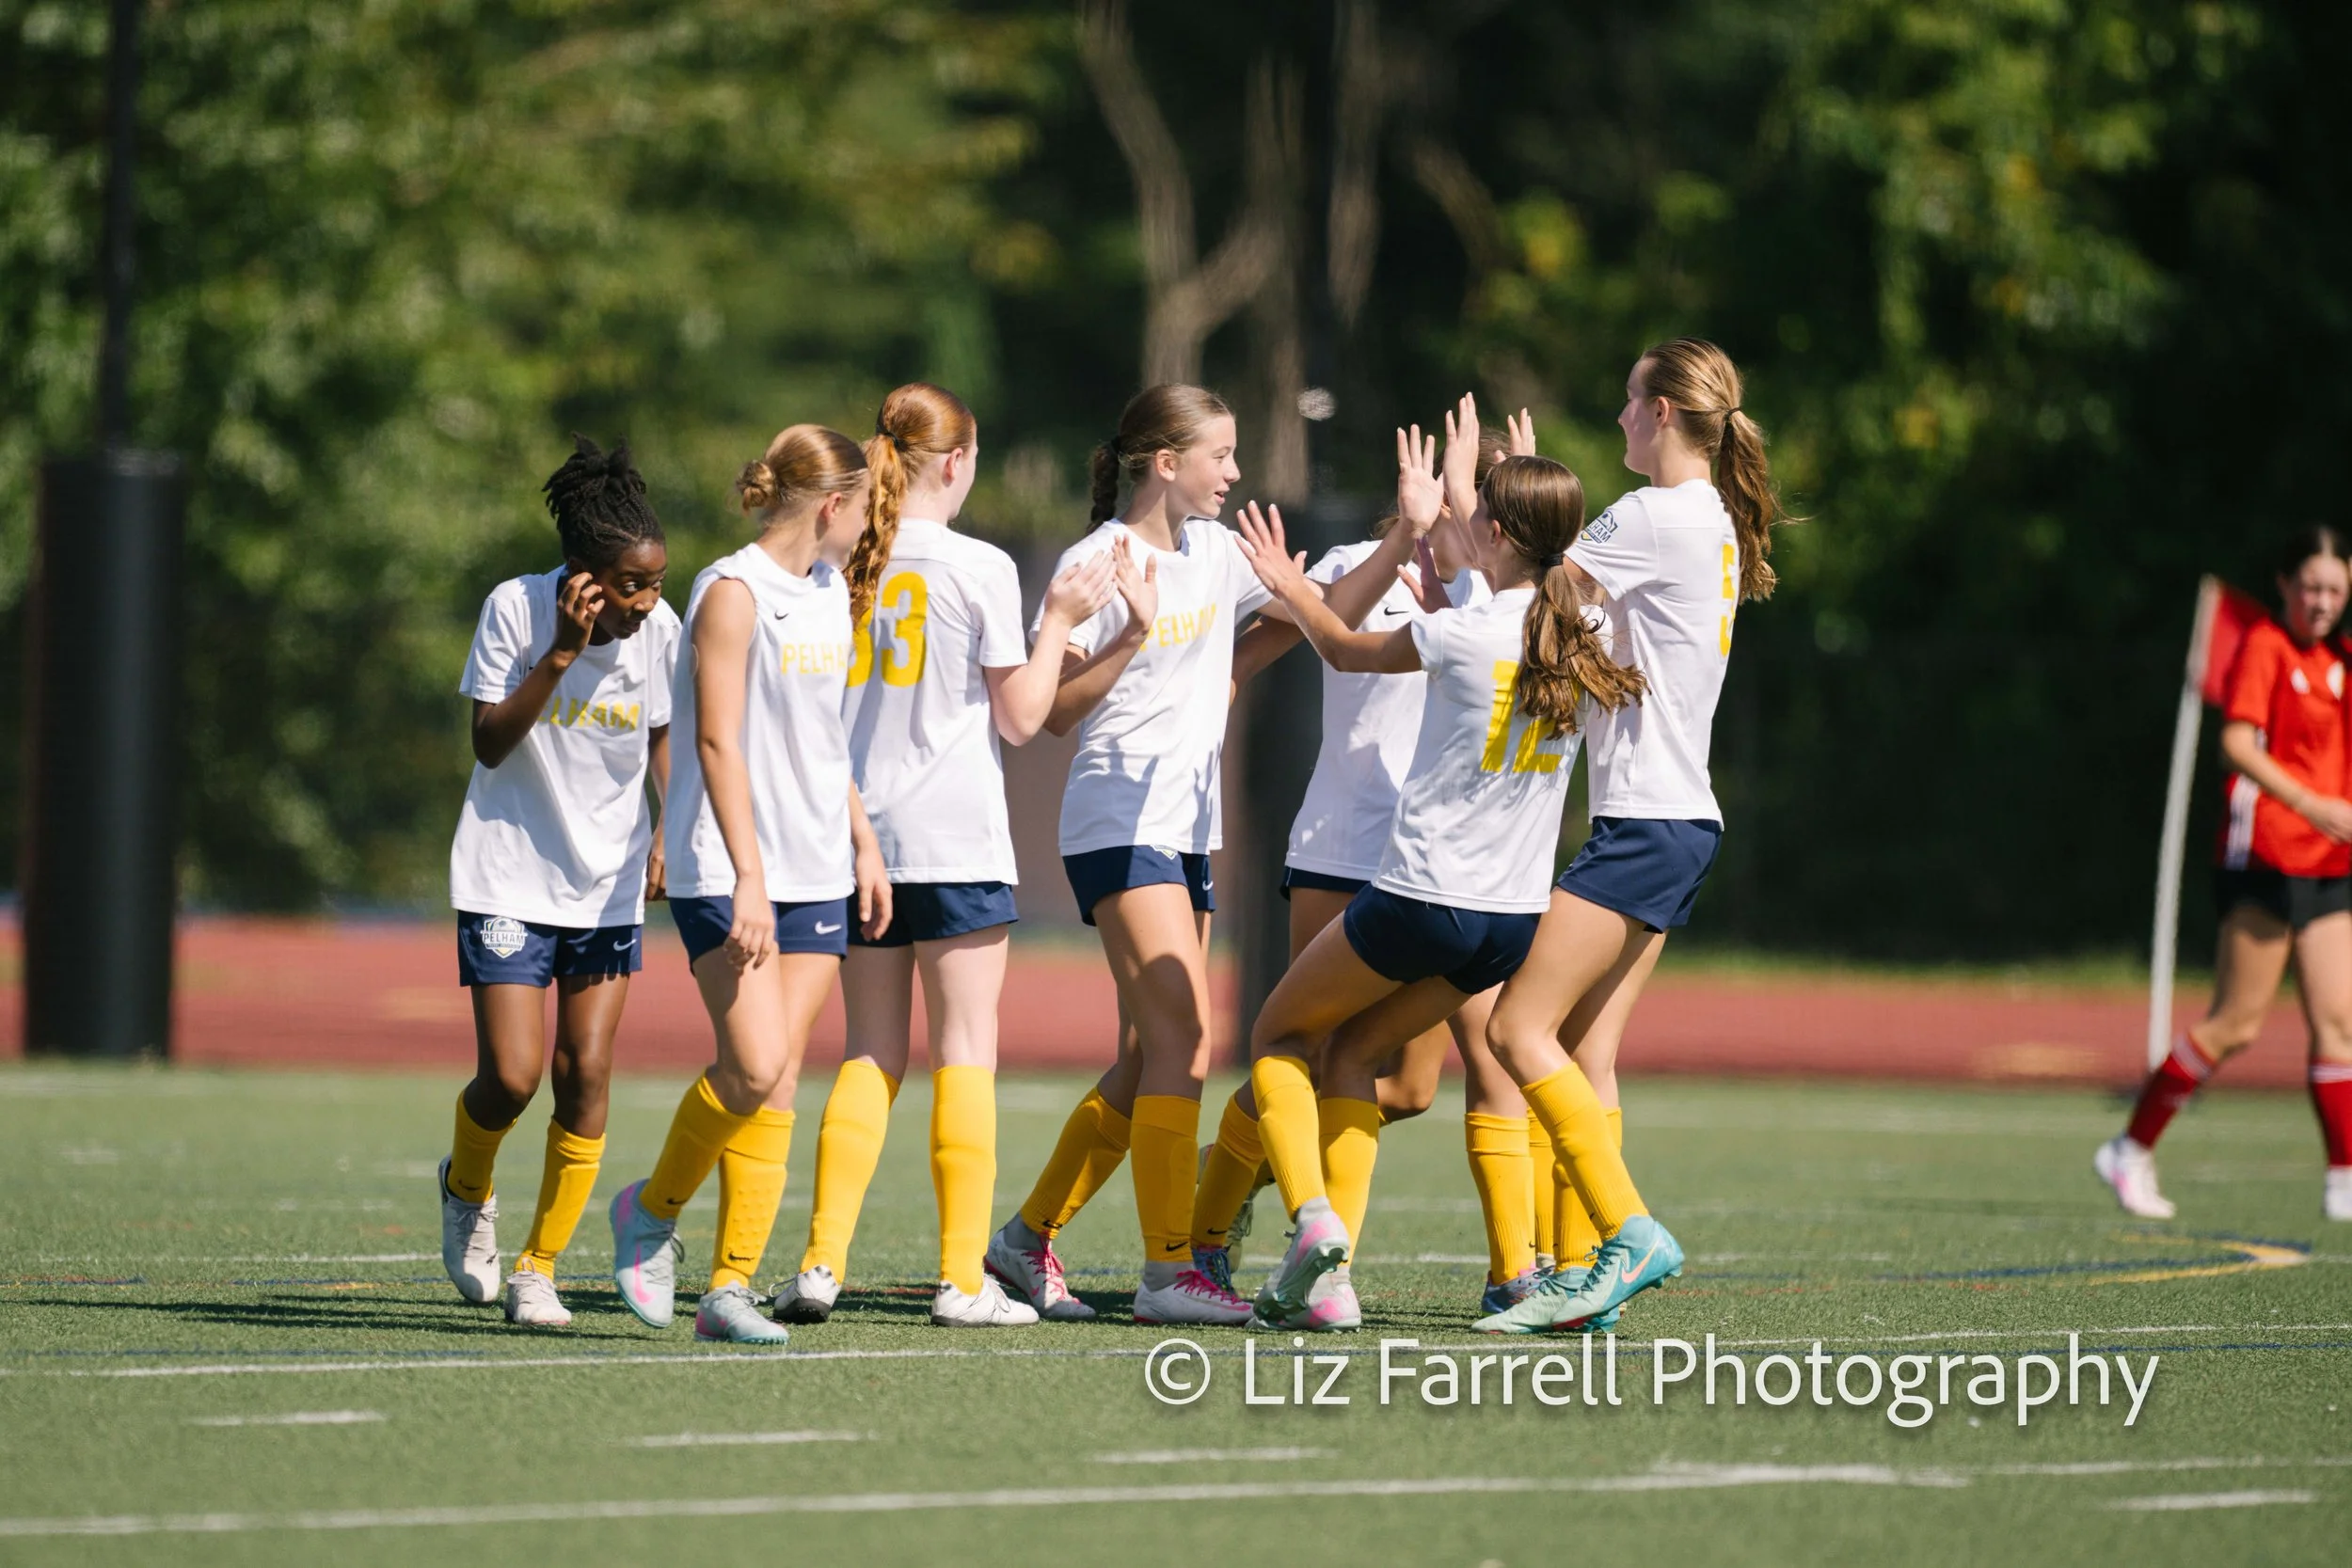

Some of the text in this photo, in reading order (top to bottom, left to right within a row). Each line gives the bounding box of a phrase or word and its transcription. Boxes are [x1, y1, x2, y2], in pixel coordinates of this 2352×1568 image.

[780, 641, 849, 676] PELHA
[537, 697, 641, 731] LHAM
[484, 932, 524, 944] PELHAM
